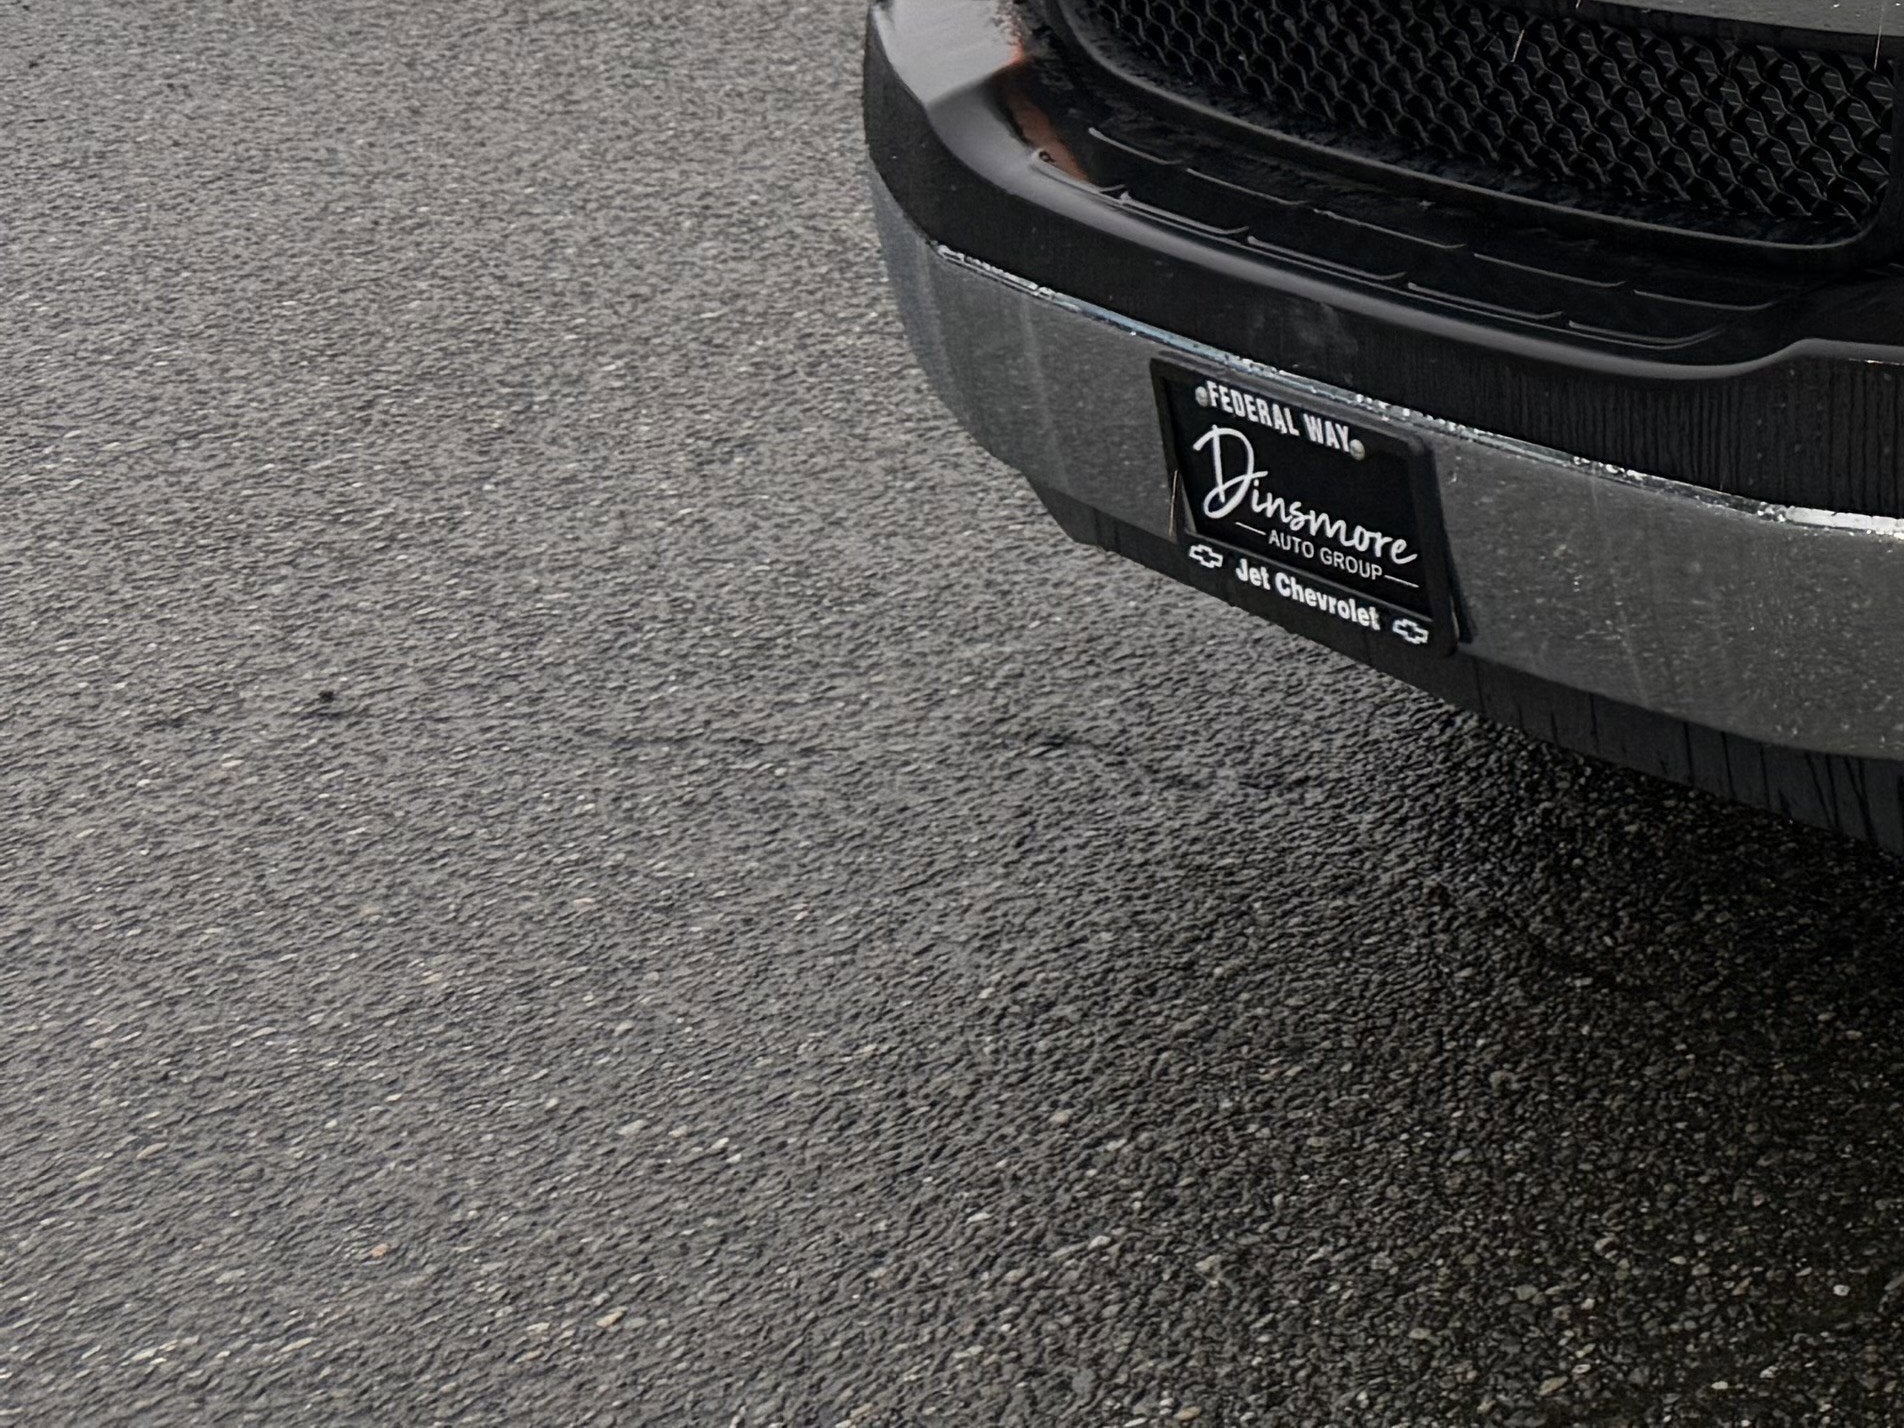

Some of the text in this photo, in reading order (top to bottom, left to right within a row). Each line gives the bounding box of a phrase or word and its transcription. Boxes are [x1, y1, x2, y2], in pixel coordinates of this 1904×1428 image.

[1207, 380, 1350, 452] FEDERAL WAY
[1192, 424, 1418, 565] Dinsmore
[1268, 529, 1383, 580] AUTO GROUP
[1235, 557, 1380, 630] Jet Chevrolet
